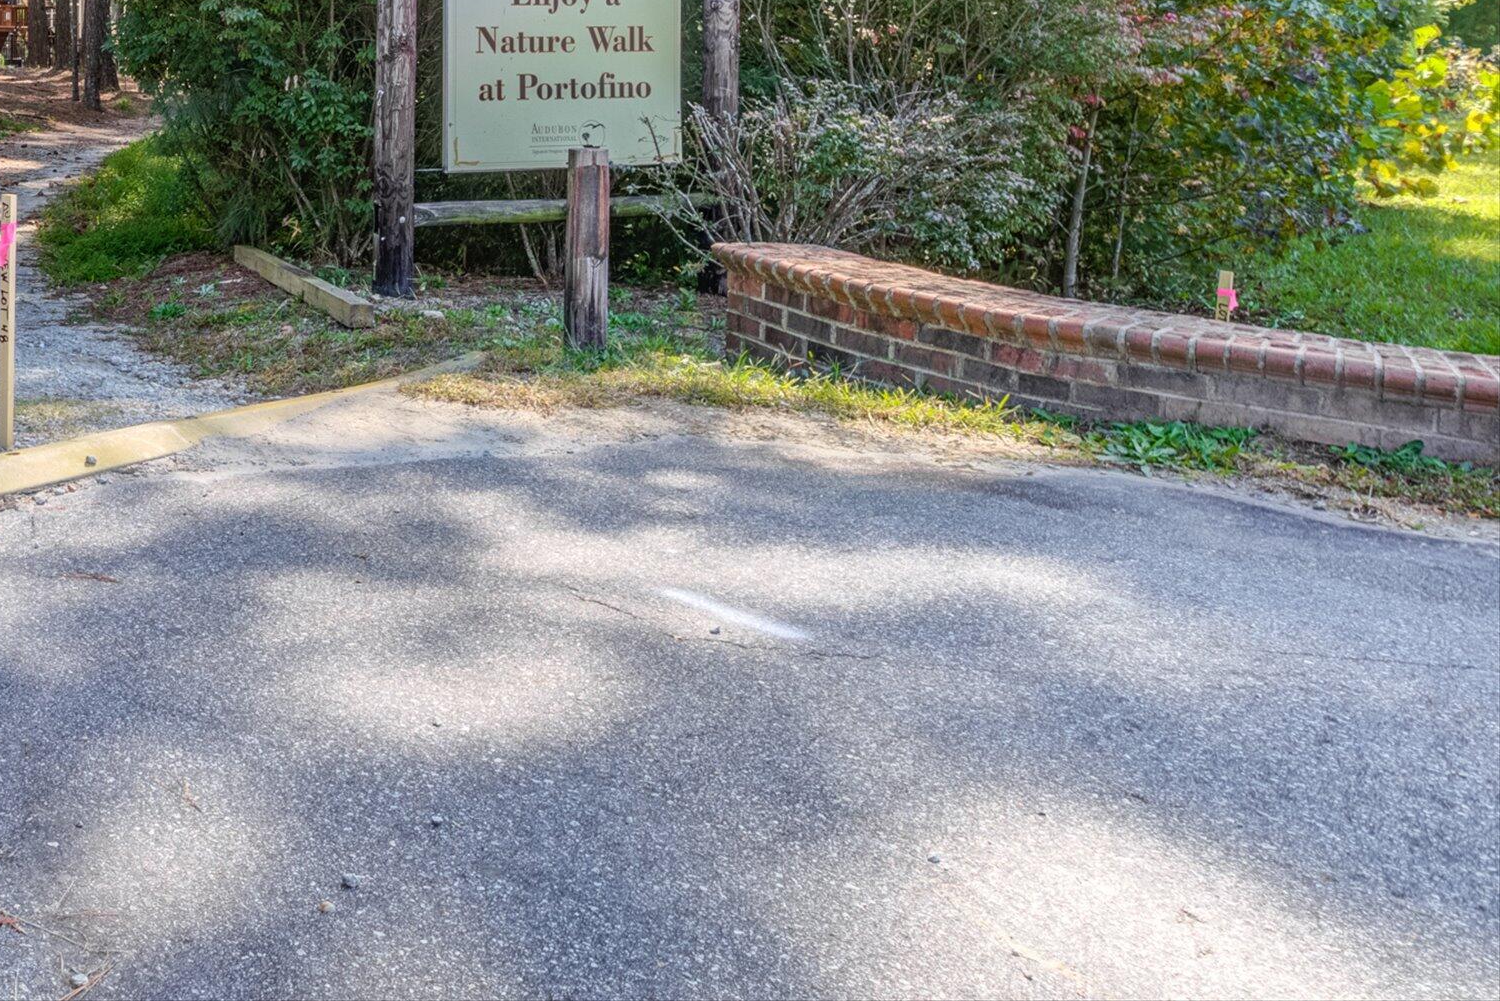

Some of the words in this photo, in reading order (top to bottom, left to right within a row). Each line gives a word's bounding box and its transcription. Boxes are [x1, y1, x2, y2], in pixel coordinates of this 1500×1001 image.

[476, 26, 576, 54] Nature
[586, 25, 655, 53] Walk
[478, 79, 506, 102] at
[516, 72, 652, 101] Portofino
[531, 123, 577, 134] AUDUBON
[0, 290, 9, 320] LOT
